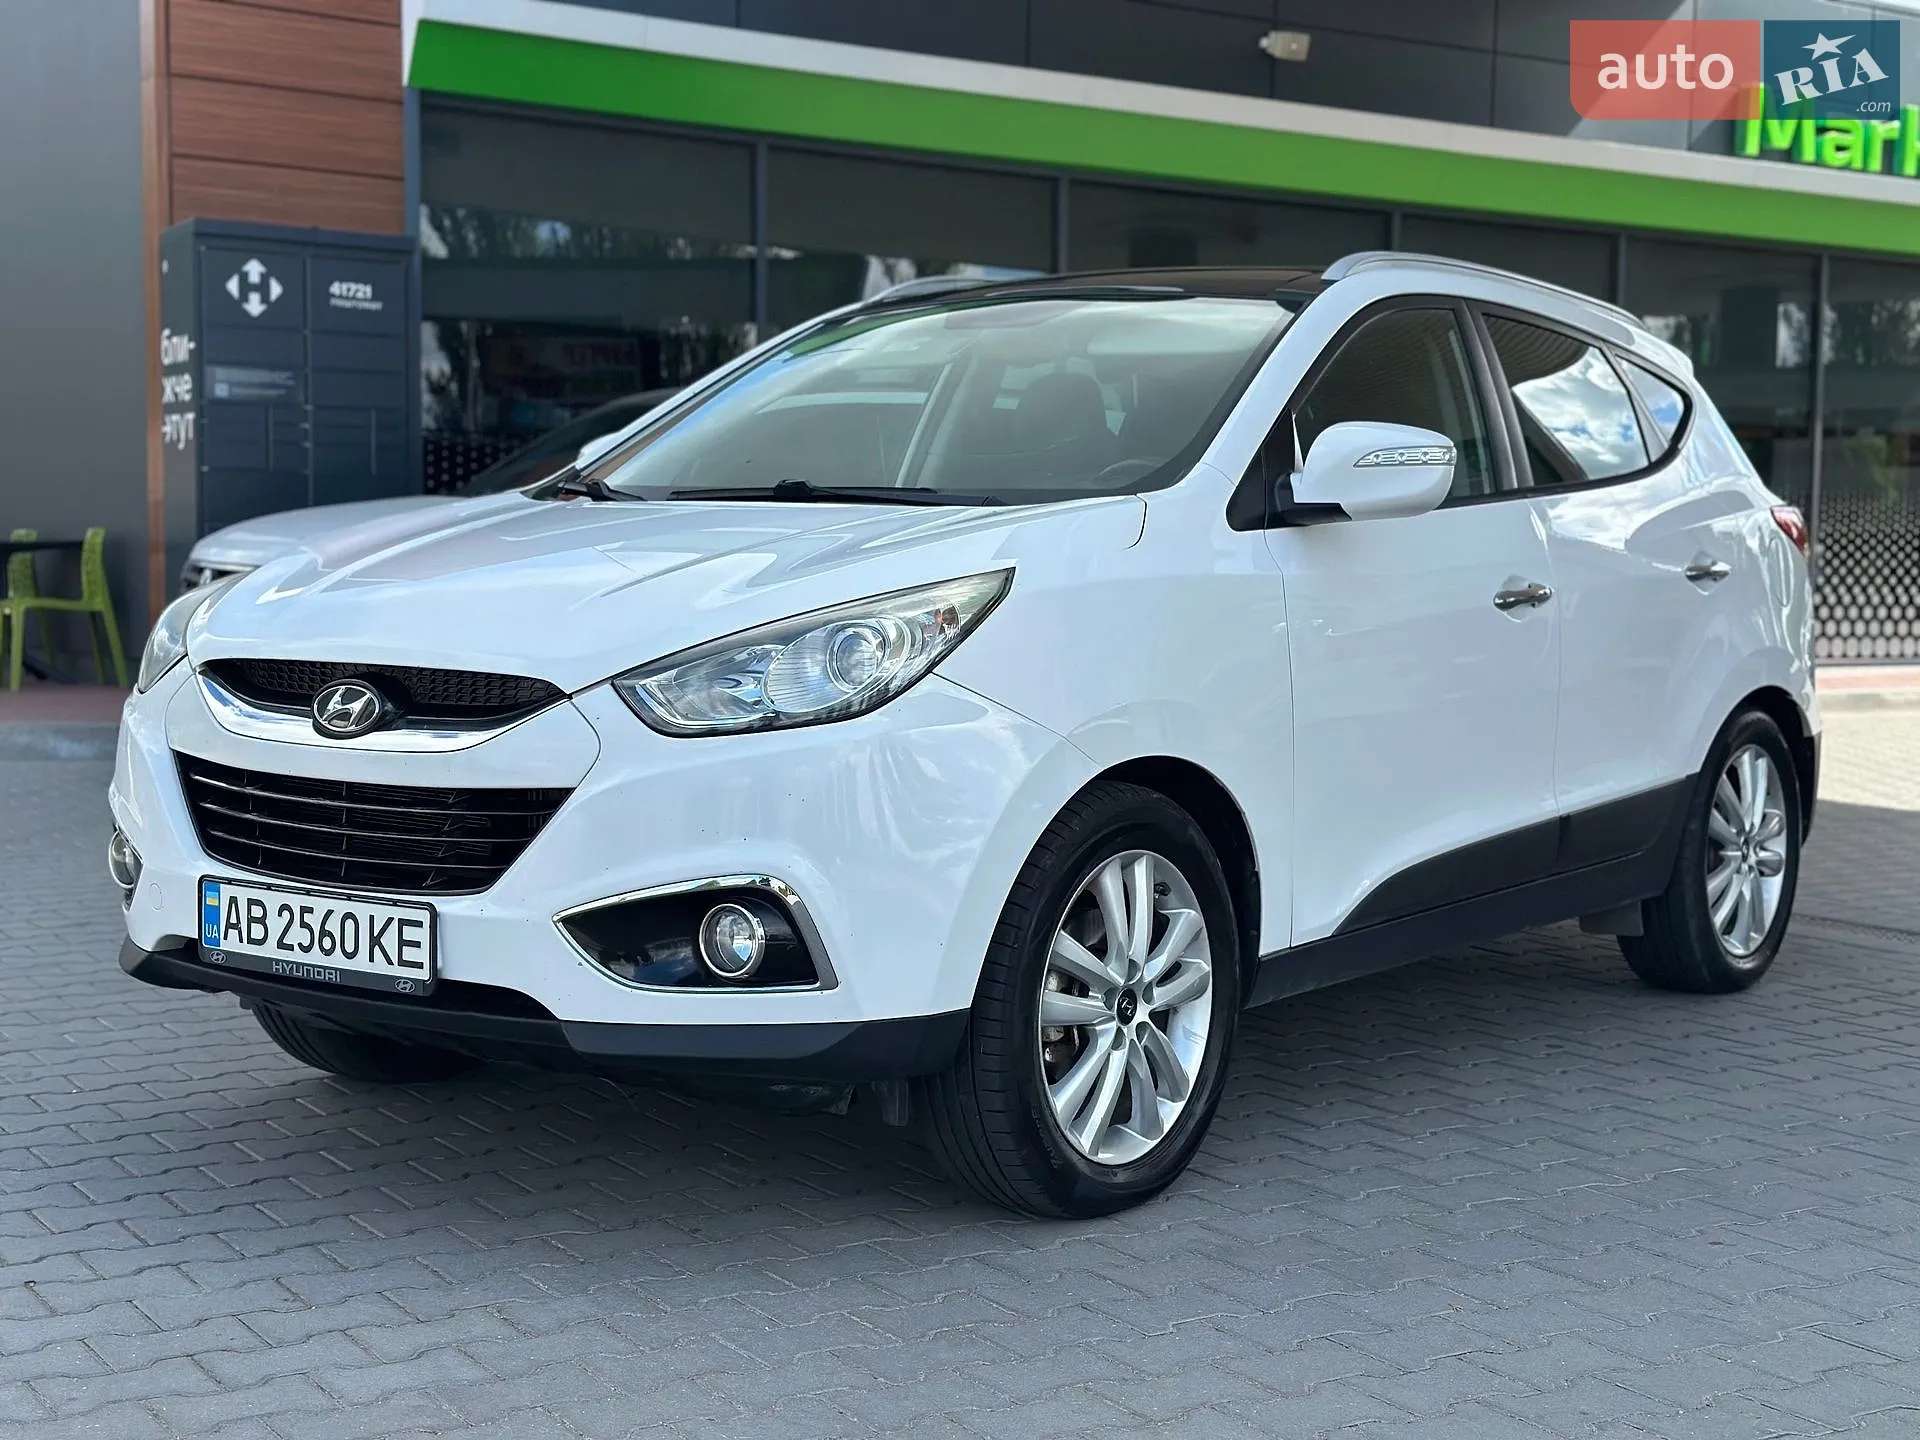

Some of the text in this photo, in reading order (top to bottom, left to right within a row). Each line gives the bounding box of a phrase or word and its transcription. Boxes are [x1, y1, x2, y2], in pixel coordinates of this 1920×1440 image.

[329, 280, 373, 300] 41721
[205, 923, 220, 940] UA
[223, 895, 424, 970] AB 2560 KE
[272, 960, 342, 983] HYUNDAI
